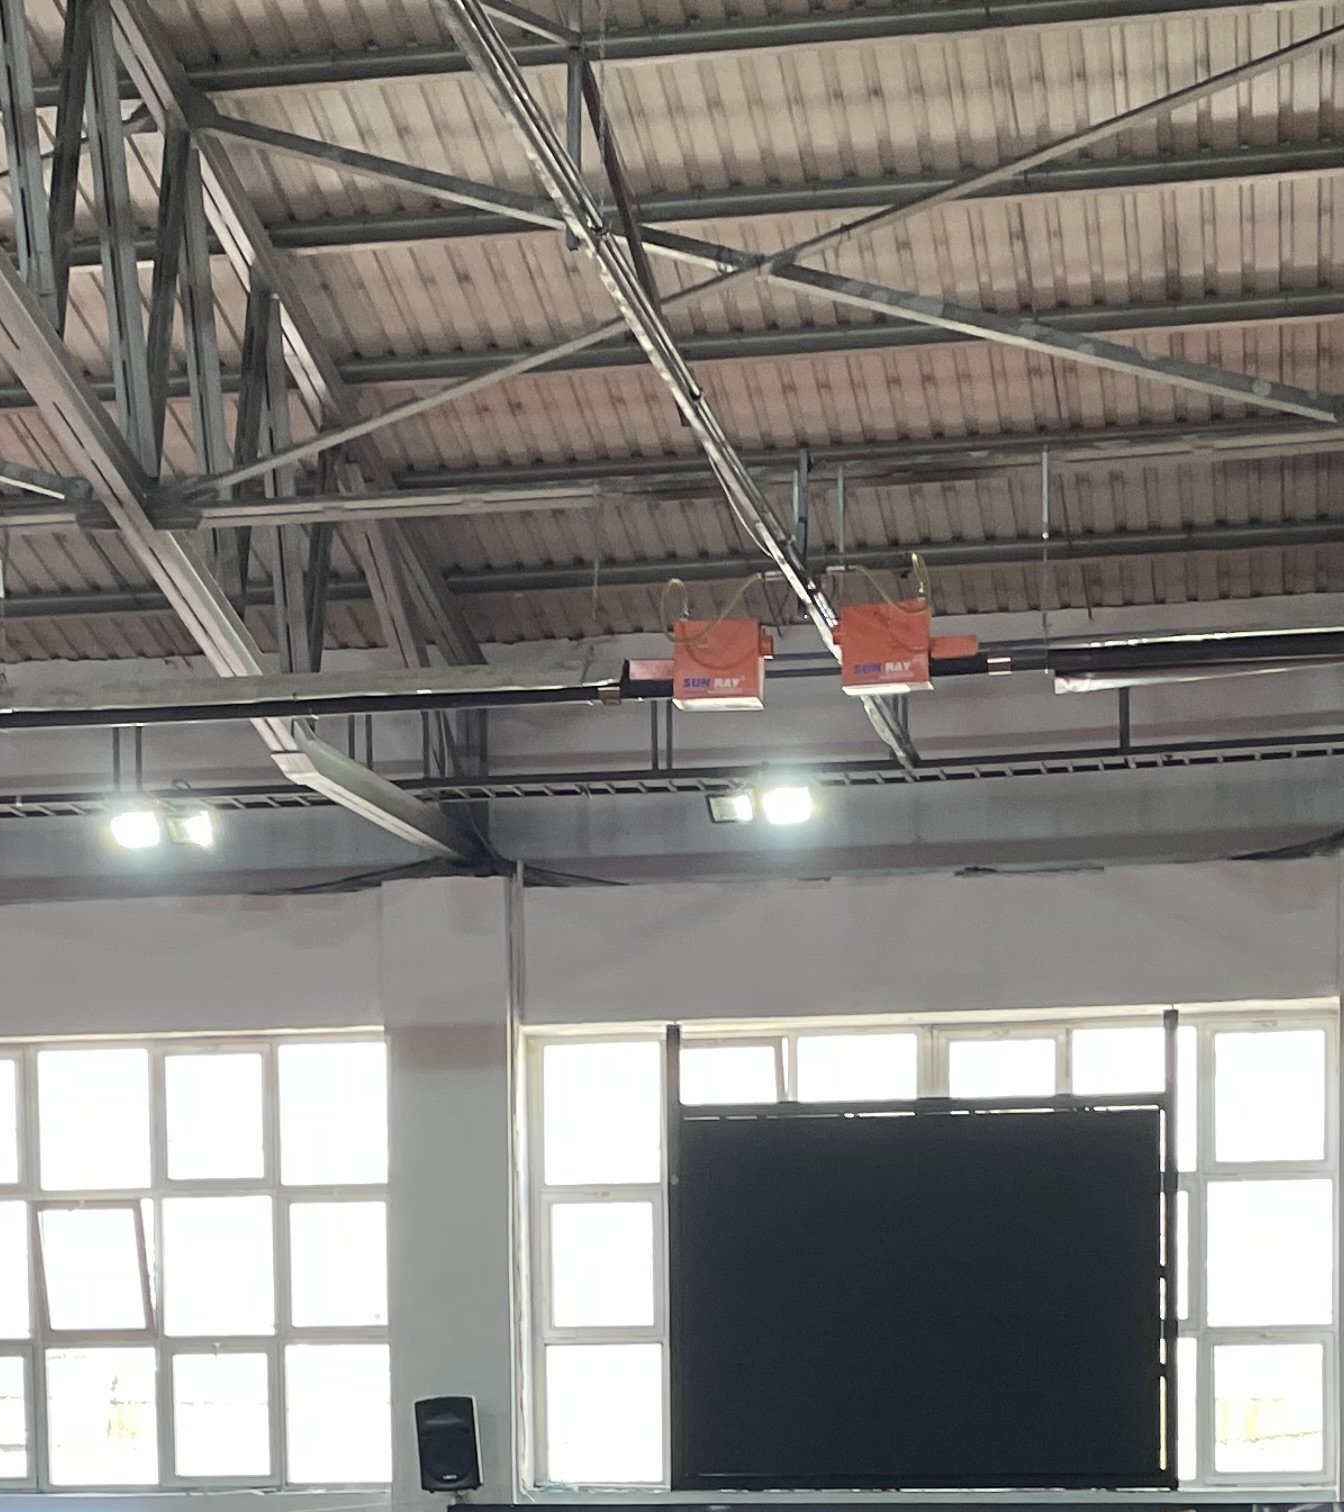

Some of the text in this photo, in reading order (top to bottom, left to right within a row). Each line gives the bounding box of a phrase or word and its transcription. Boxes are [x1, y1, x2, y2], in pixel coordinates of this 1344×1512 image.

[884, 661, 912, 672] RAY
[683, 677, 740, 688] SUN RAY
